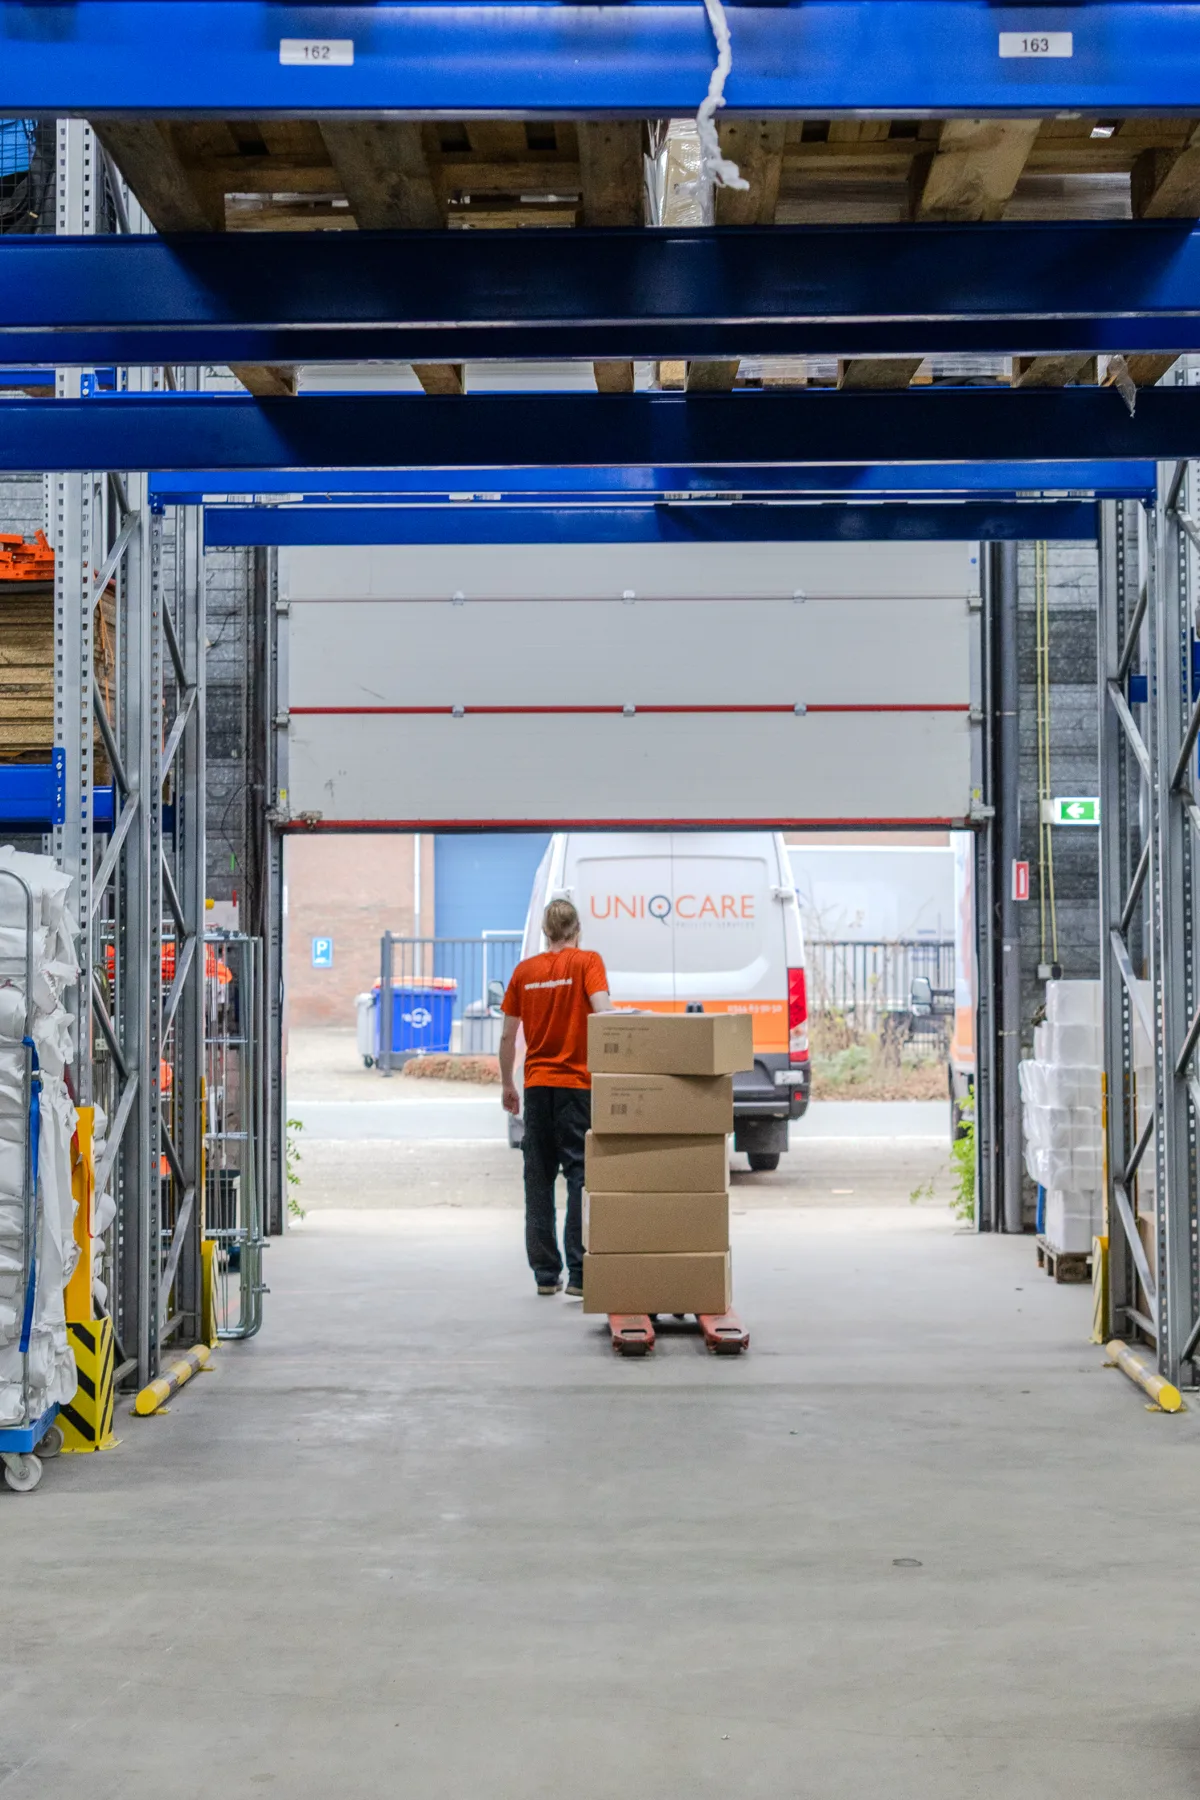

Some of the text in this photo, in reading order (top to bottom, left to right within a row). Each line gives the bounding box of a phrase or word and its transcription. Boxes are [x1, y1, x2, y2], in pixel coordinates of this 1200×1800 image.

[303, 45, 331, 60] 162
[1021, 38, 1049, 53] 163
[590, 894, 755, 928] UNIQCARE
[316, 940, 328, 956] P
